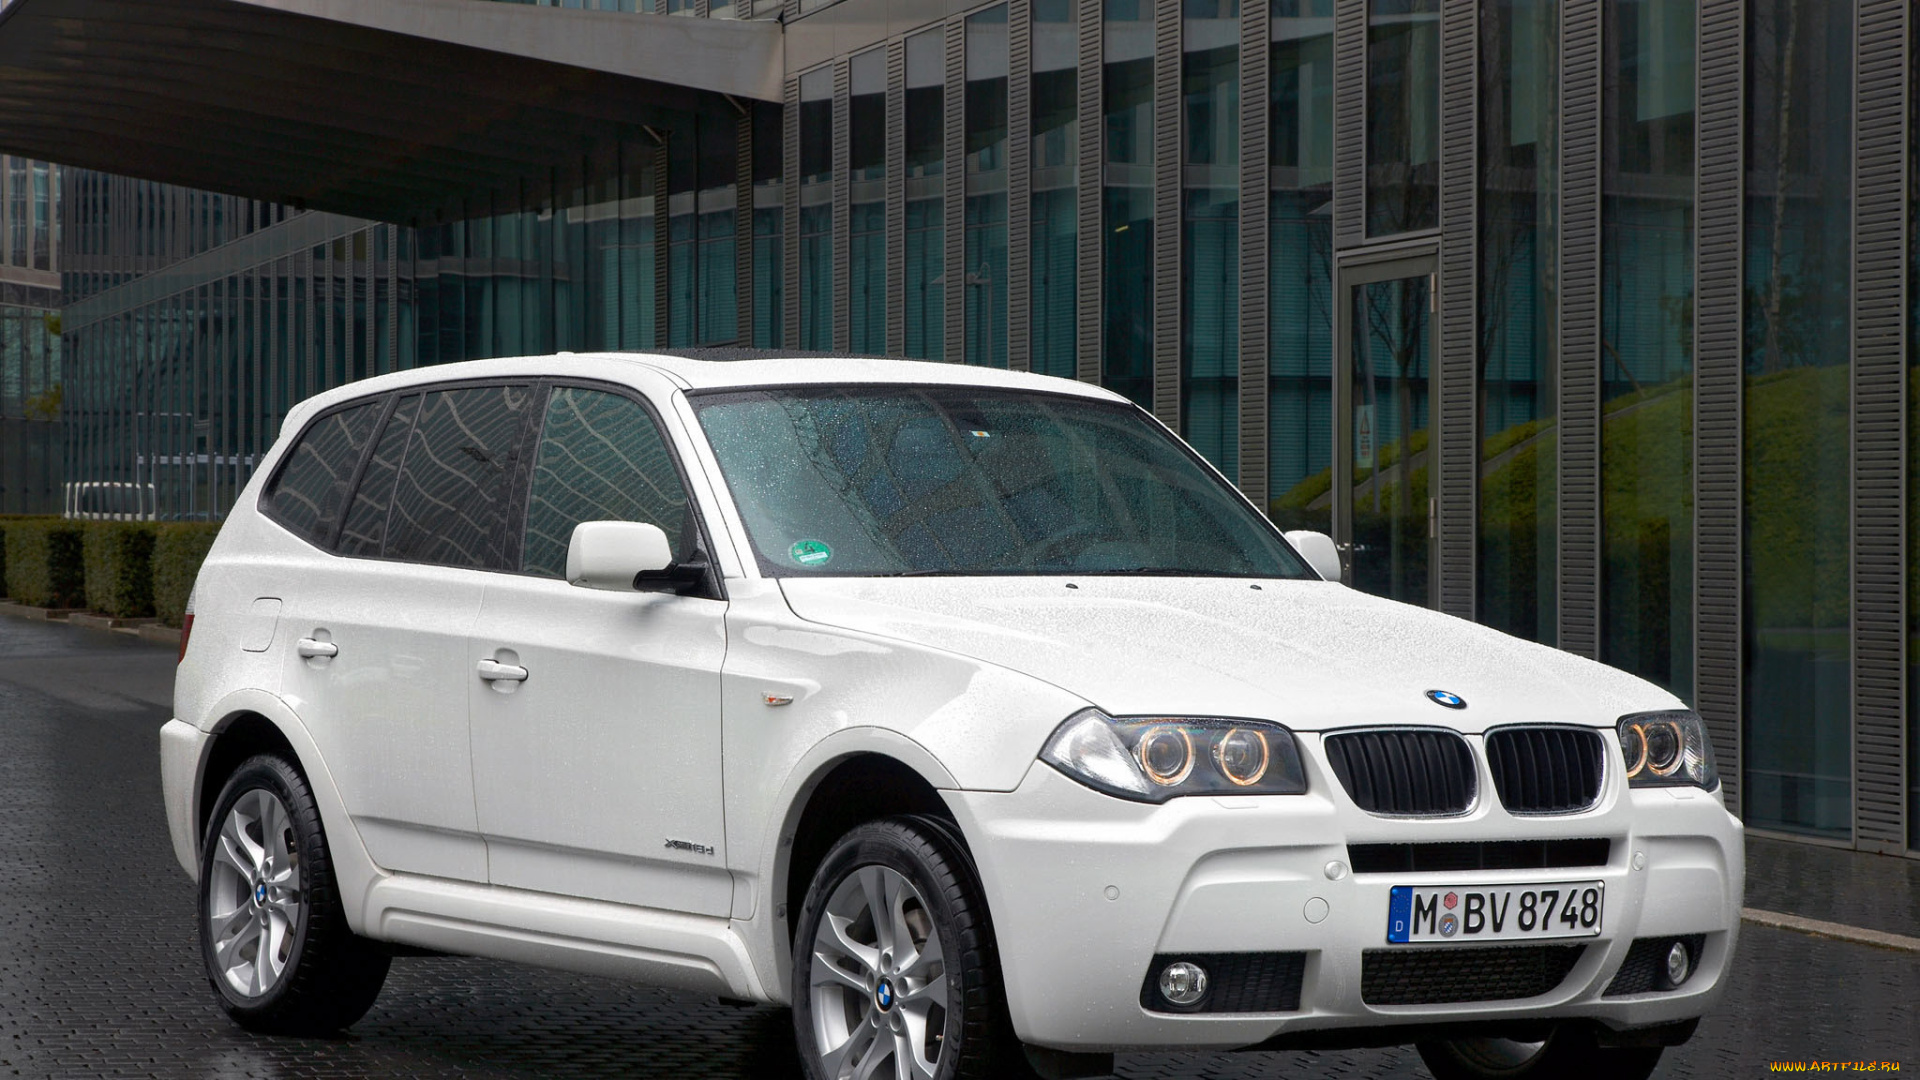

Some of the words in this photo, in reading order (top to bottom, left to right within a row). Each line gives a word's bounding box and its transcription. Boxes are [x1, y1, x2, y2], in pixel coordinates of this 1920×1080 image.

[1395, 920, 1403, 932] D
[1413, 893, 1438, 935] M
[1463, 892, 1511, 934] BV
[1518, 888, 1598, 932] 8748
